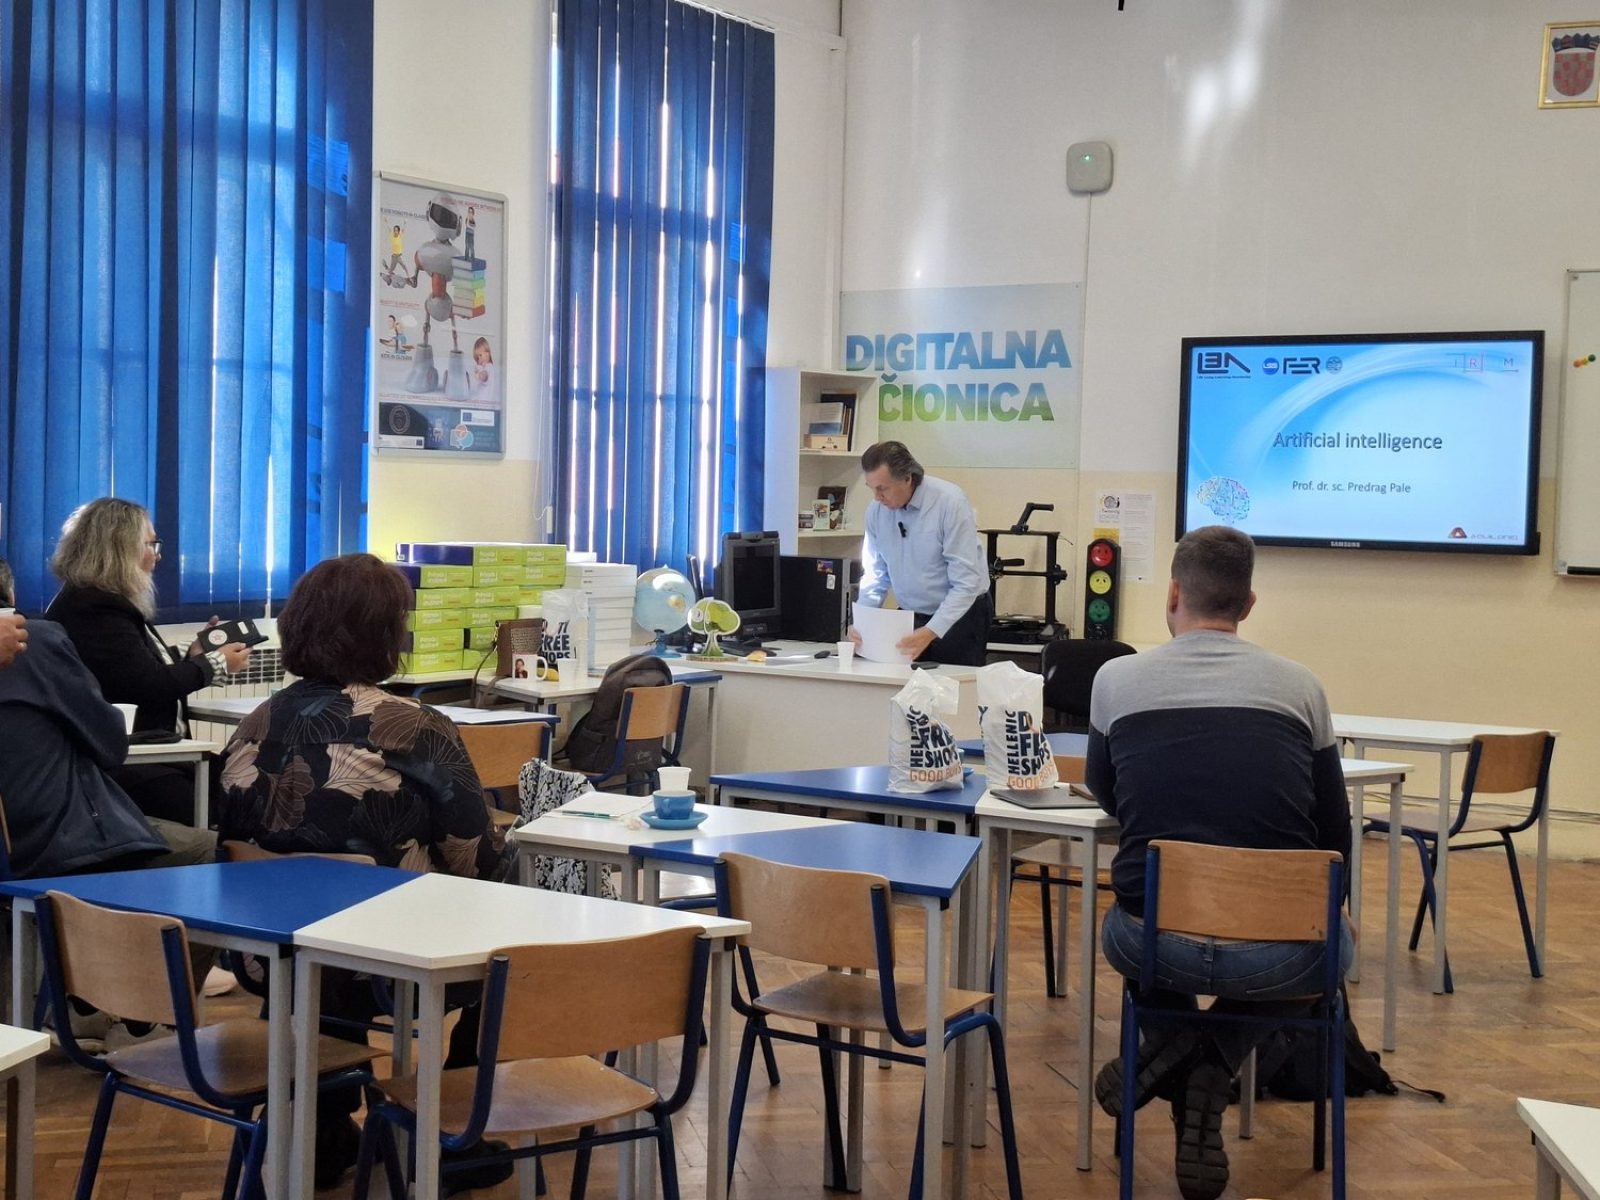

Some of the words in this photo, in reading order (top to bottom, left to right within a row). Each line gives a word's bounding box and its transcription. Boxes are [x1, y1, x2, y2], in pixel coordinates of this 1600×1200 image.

[846, 329, 1072, 371] DIGITALNA
[1283, 357, 1321, 374] FER
[879, 373, 1054, 422] ČIONICA
[1273, 432, 1341, 449] Artificial
[1345, 432, 1443, 452] intelligence
[1292, 481, 1314, 491] Prof.
[1317, 481, 1329, 491] dr.
[1332, 483, 1344, 492] sc.
[1348, 481, 1386, 495] Predrag
[1390, 482, 1411, 493] Pale
[1005, 709, 1020, 775] HELLENIC
[910, 769, 944, 782] GOOD
